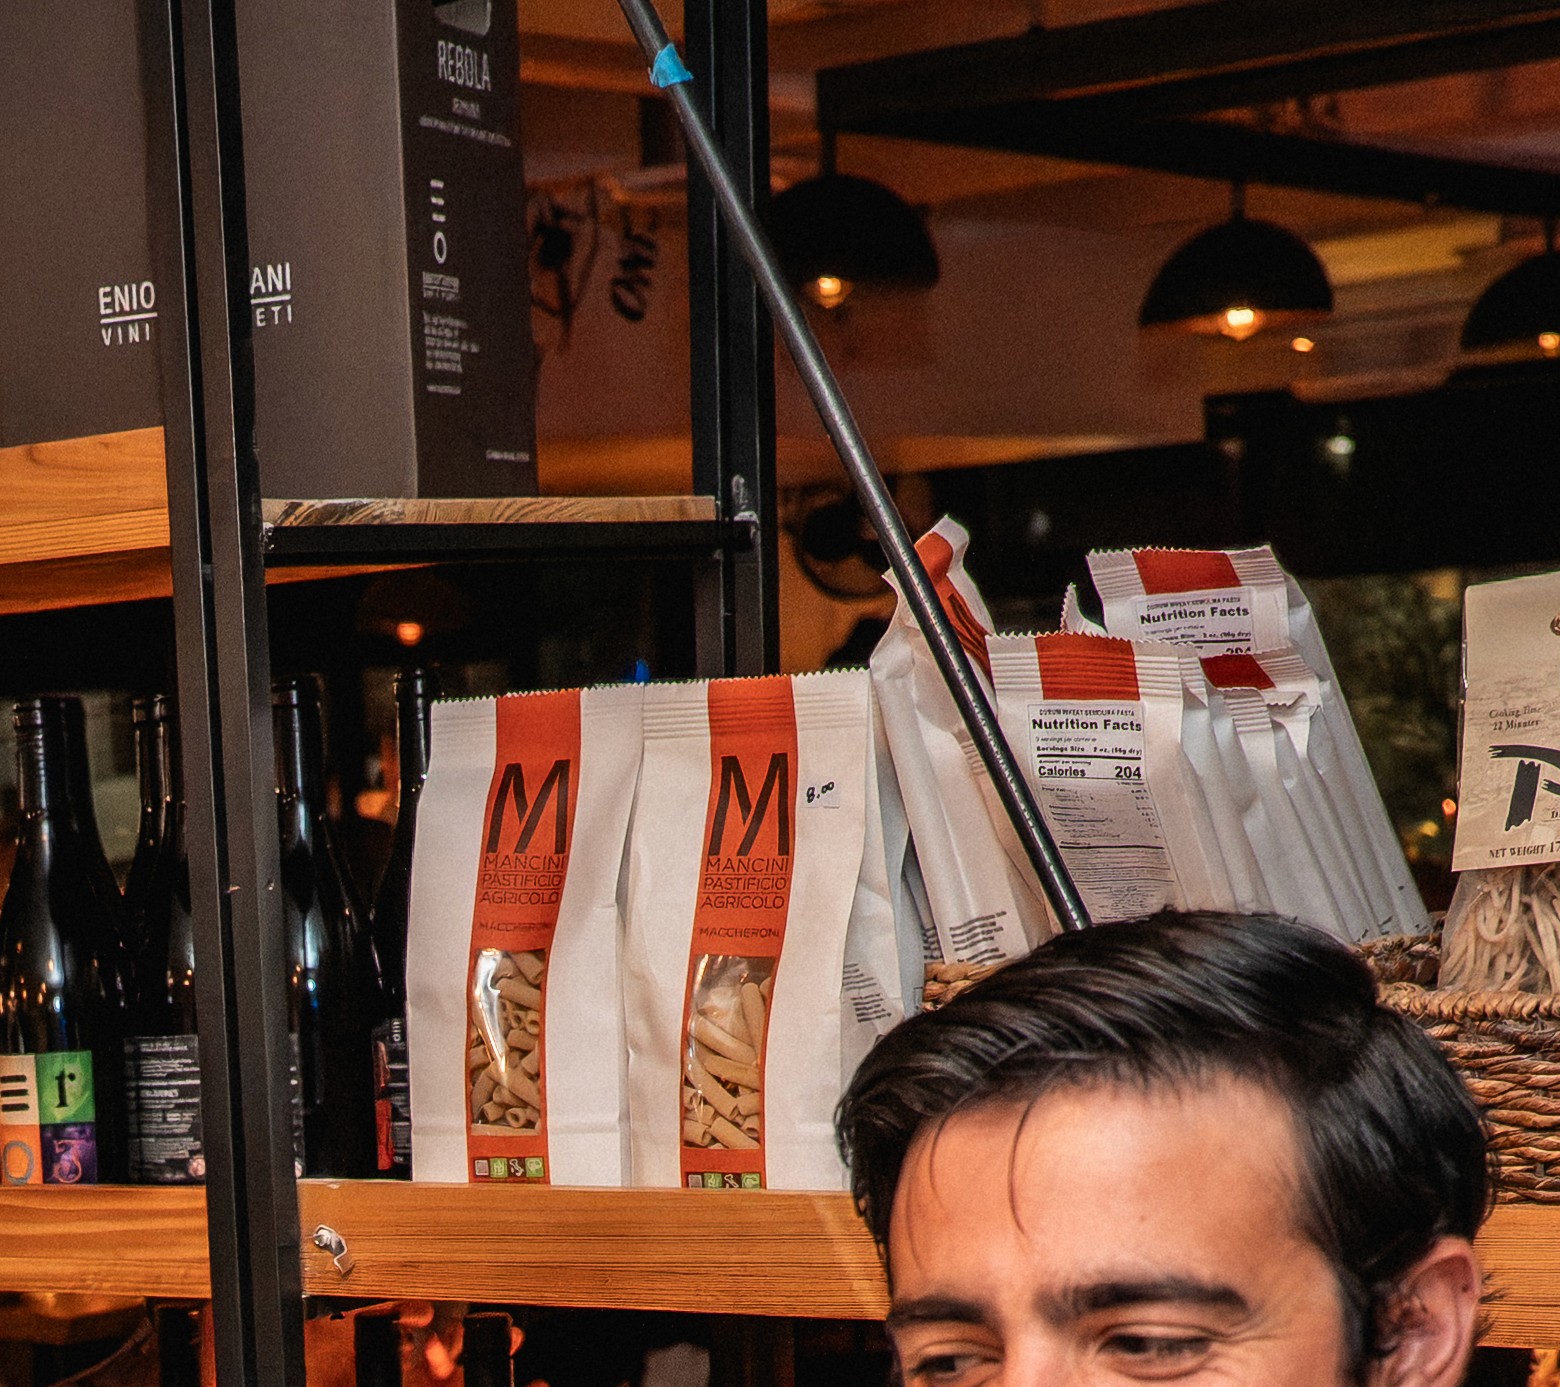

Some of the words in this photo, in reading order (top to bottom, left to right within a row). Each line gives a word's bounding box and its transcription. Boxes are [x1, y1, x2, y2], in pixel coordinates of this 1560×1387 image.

[437, 40, 492, 92] REBOLA
[99, 281, 155, 315] ENIO
[101, 322, 151, 347] VINI
[1141, 609, 1205, 624] Nutrition
[1210, 607, 1249, 617] Facts
[1032, 718, 1098, 730] Nutrition
[1103, 719, 1142, 731] Facts
[1038, 766, 1086, 777] Calories
[1114, 766, 1141, 779] 204
[806, 781, 835, 804] 8.00
[482, 855, 564, 871] MANCINI
[705, 857, 789, 873] MANCINI
[482, 872, 562, 888] PASTIFICIO
[703, 876, 787, 891] PASTIFICIO
[480, 889, 560, 906] AGRICOLO
[699, 894, 785, 910] AGRICOLO
[698, 927, 780, 939] MACCHERONI
